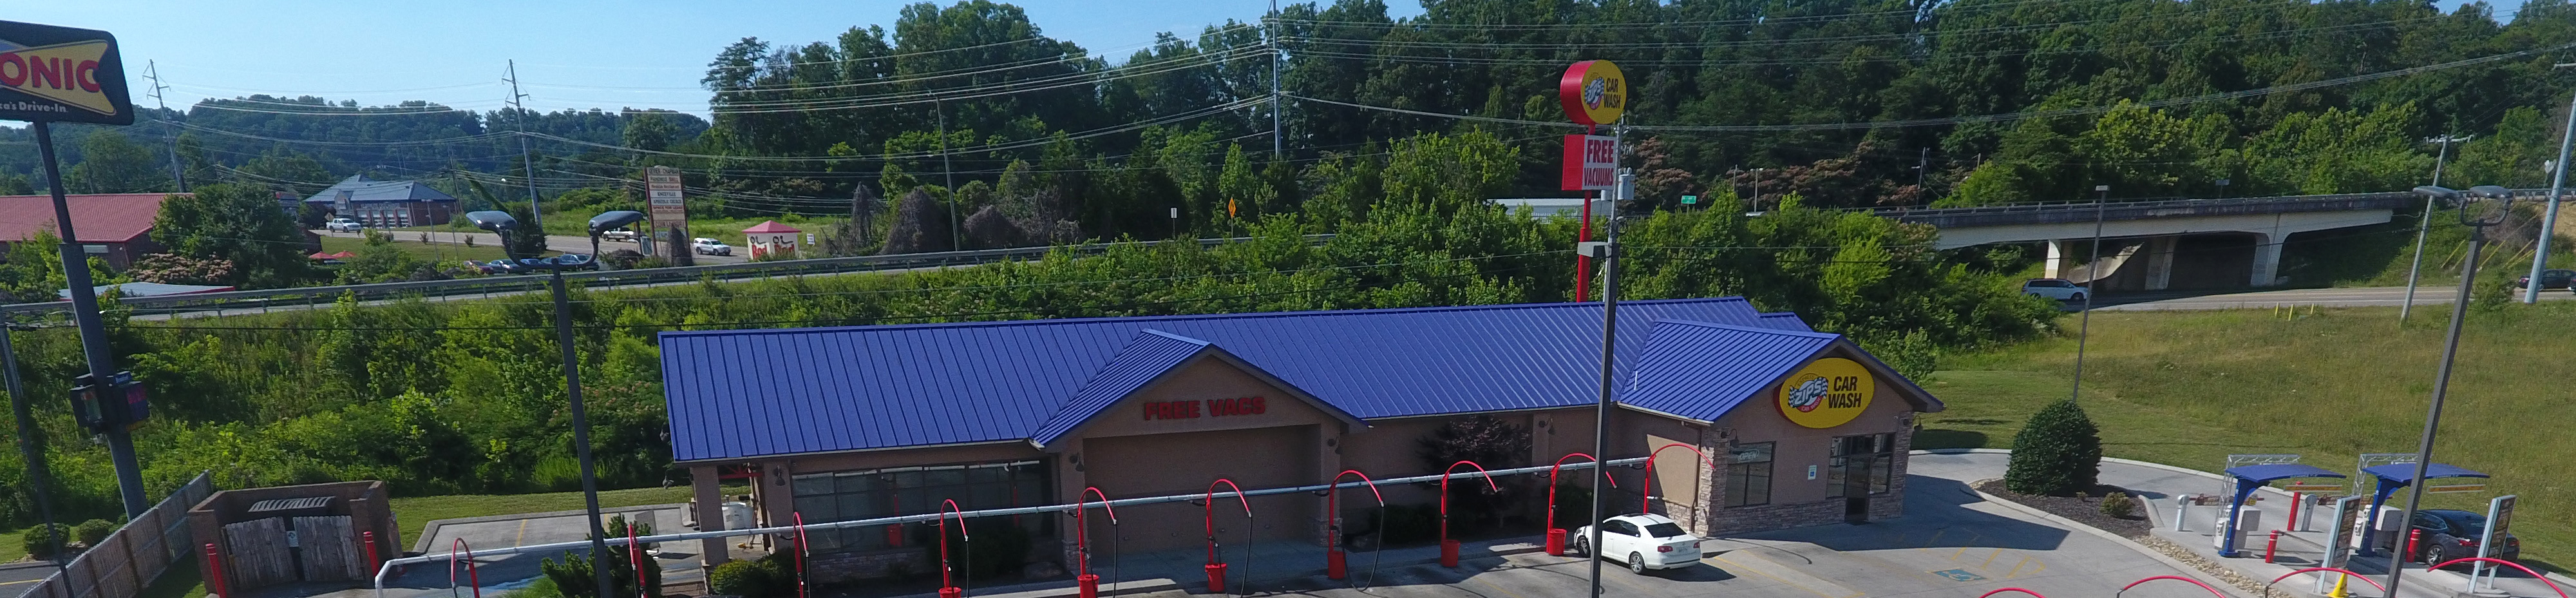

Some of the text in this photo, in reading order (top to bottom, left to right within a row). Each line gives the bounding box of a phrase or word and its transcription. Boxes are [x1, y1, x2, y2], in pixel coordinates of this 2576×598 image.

[1606, 78, 1618, 92] CAR
[1604, 94, 1620, 108] WASH
[1587, 139, 1615, 164] FREE
[1584, 168, 1614, 186] VACUUMS
[1833, 376, 1858, 391] CAR
[1794, 380, 1823, 405] ZIPS
[1828, 392, 1862, 409] WASH
[1144, 397, 1265, 420] FREE VACS
[1739, 451, 1757, 460] OPEN
